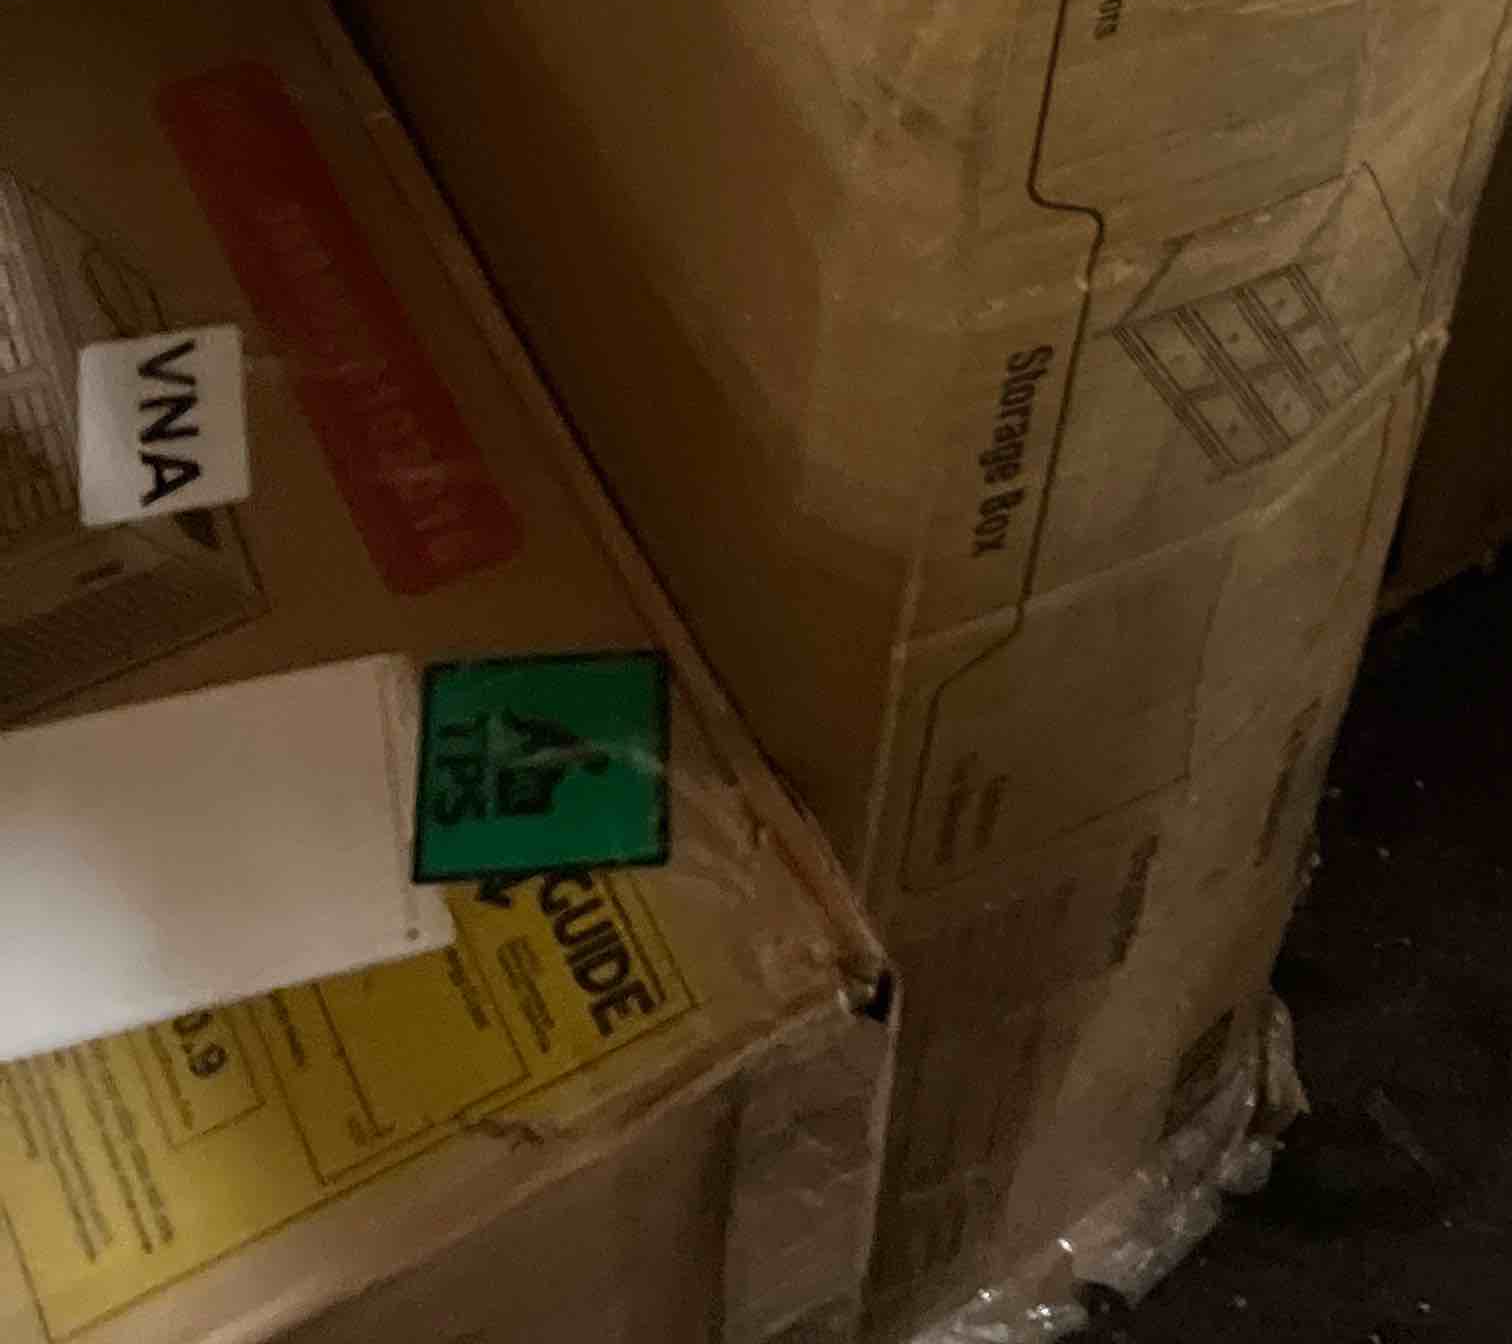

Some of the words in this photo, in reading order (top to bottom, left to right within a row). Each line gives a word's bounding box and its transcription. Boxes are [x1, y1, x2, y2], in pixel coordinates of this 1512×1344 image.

[137, 339, 202, 508] VNA
[978, 345, 1053, 479] Storage
[971, 481, 1021, 558] Box
[540, 870, 658, 1038] GUIDE
